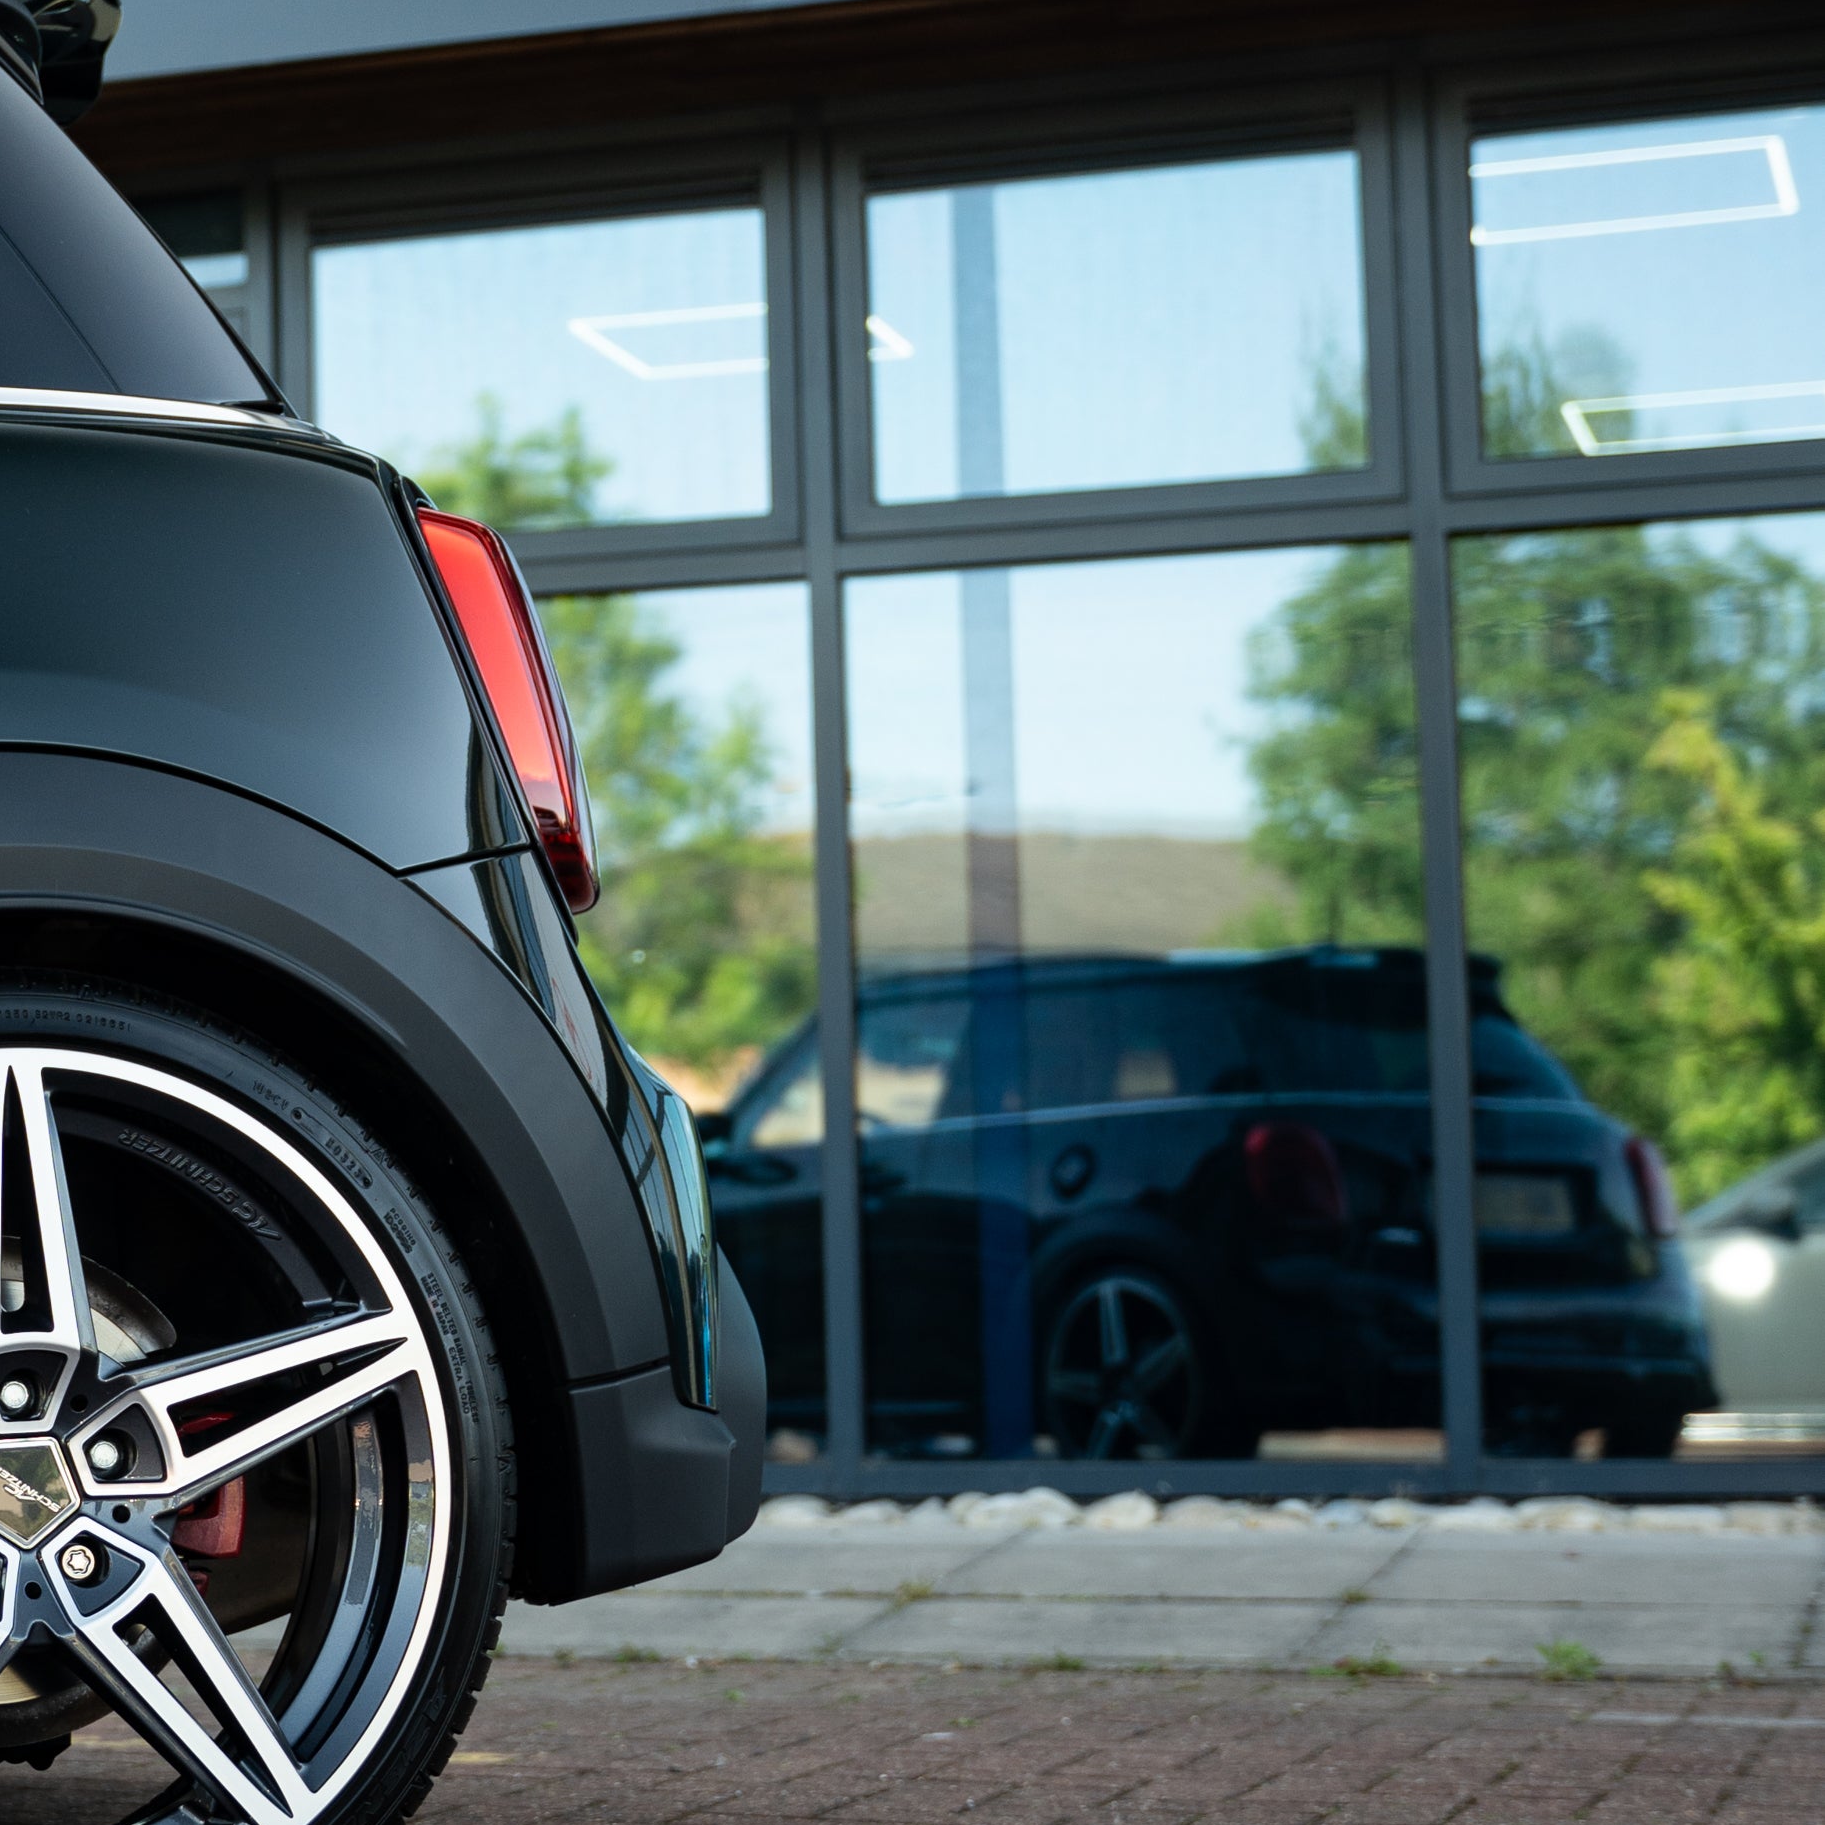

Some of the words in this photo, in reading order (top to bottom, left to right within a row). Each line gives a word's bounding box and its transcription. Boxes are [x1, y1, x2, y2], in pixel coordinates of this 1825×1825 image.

[118, 1128, 240, 1204] SCHNITZER
[420, 1276, 434, 1298] MADE
[431, 1299, 440, 1310] IN
[435, 1310, 450, 1336] JAPAN
[427, 1272, 444, 1301] STEEL
[440, 1301, 458, 1336] BELTED
[453, 1335, 468, 1366] RADIAL
[465, 1380, 480, 1424] TUBELESS
[448, 1346, 462, 1382] EXTRA
[458, 1387, 470, 1415] LOAD
